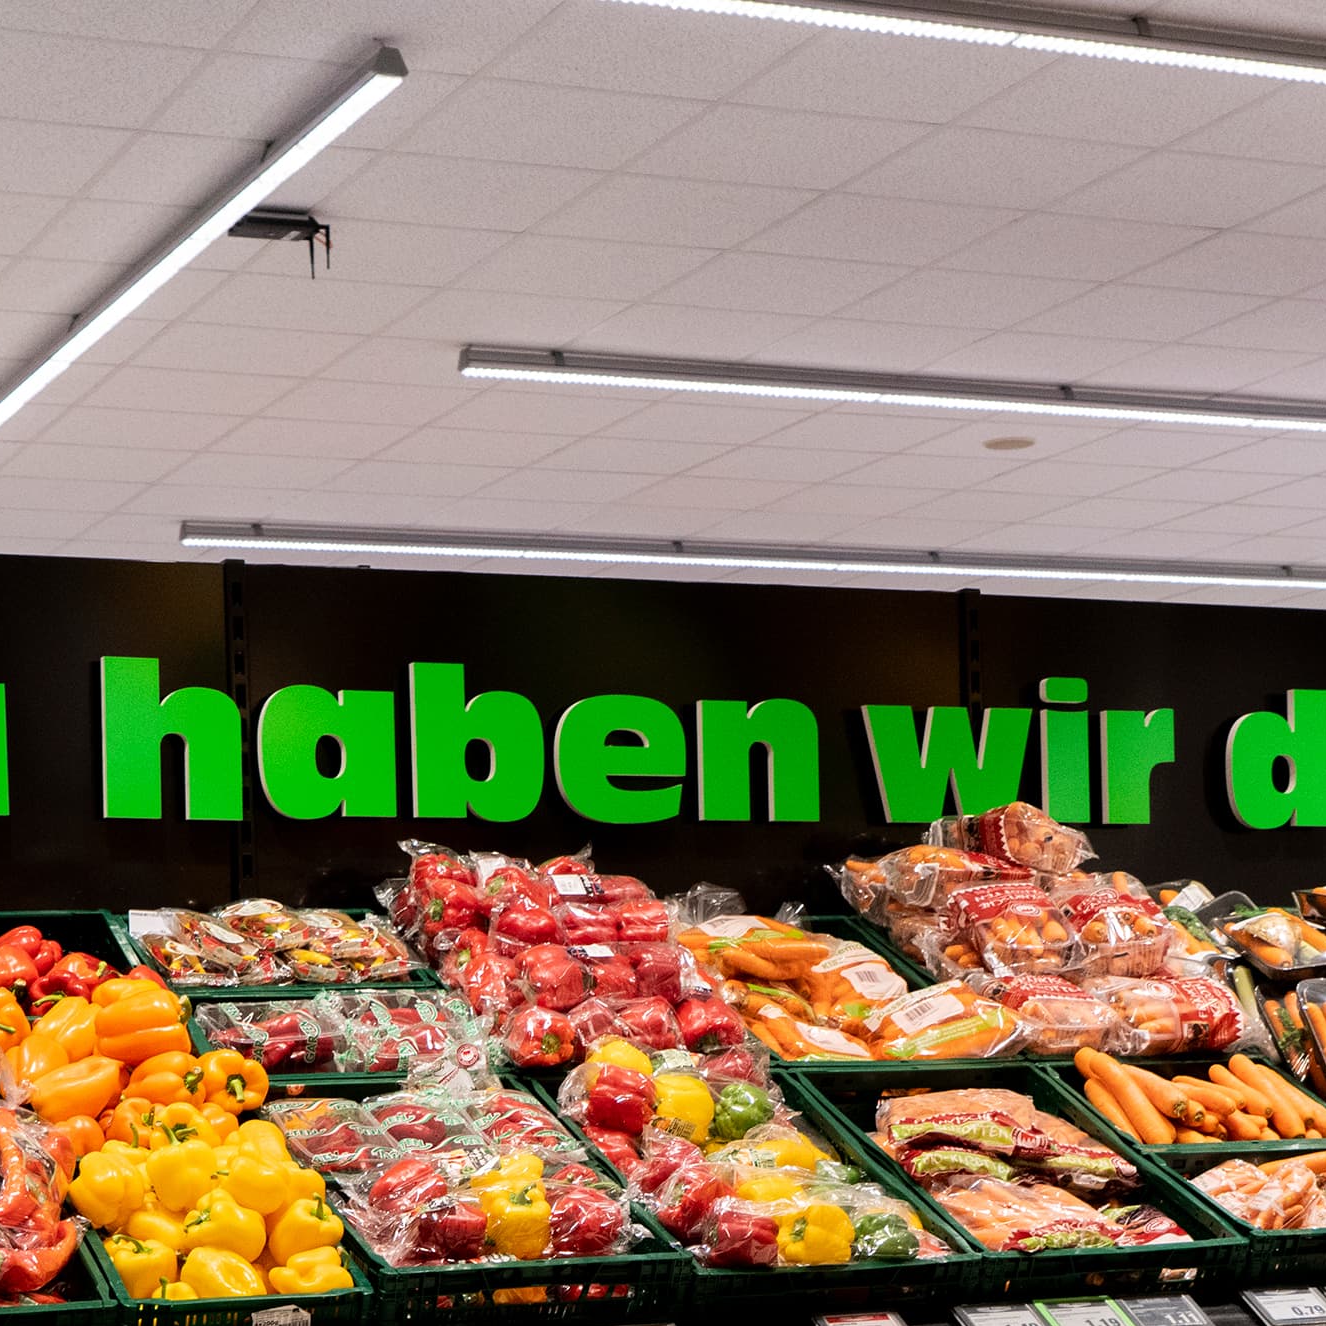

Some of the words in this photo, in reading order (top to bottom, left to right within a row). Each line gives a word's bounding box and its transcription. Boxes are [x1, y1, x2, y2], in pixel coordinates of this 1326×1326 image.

[100, 656, 820, 822] haben
[861, 677, 1175, 826] wir
[1290, 1303, 1325, 1317] 0.79
